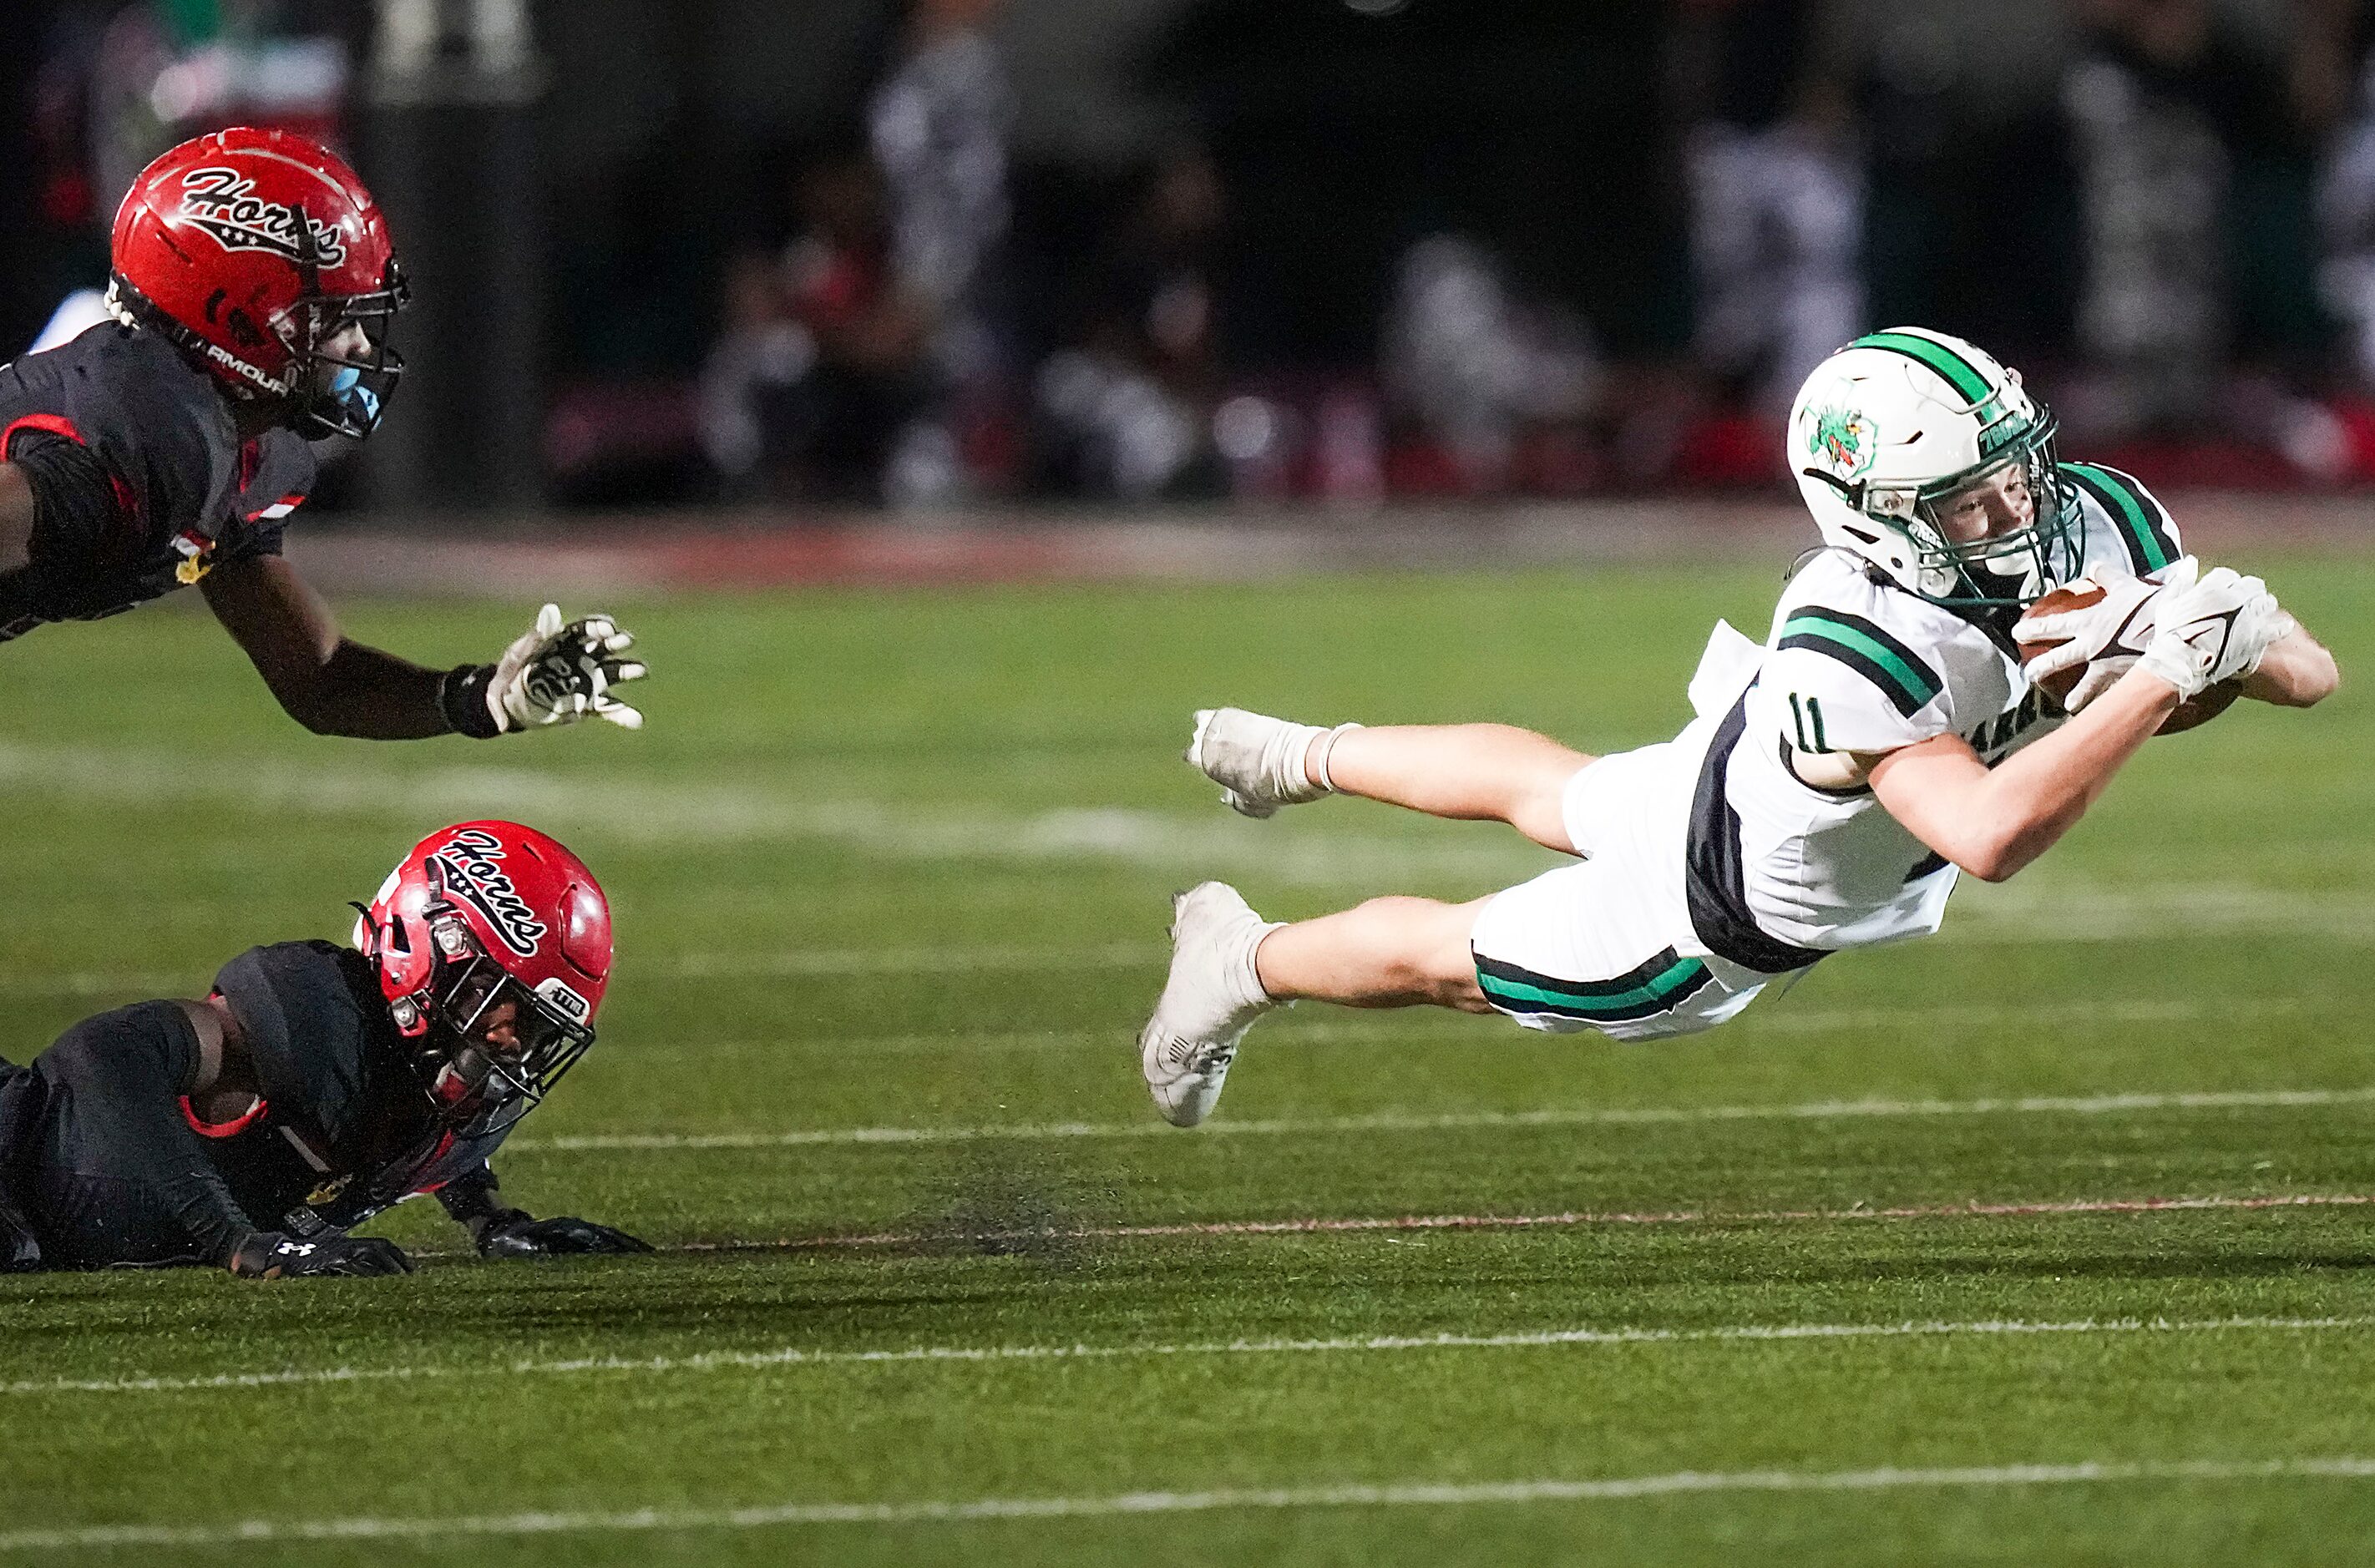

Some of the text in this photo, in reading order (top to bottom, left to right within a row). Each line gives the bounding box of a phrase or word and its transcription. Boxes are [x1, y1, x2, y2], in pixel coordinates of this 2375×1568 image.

[203, 343, 289, 397] RMOUR
[1789, 691, 1835, 755] 11
[438, 829, 548, 958] Horns
